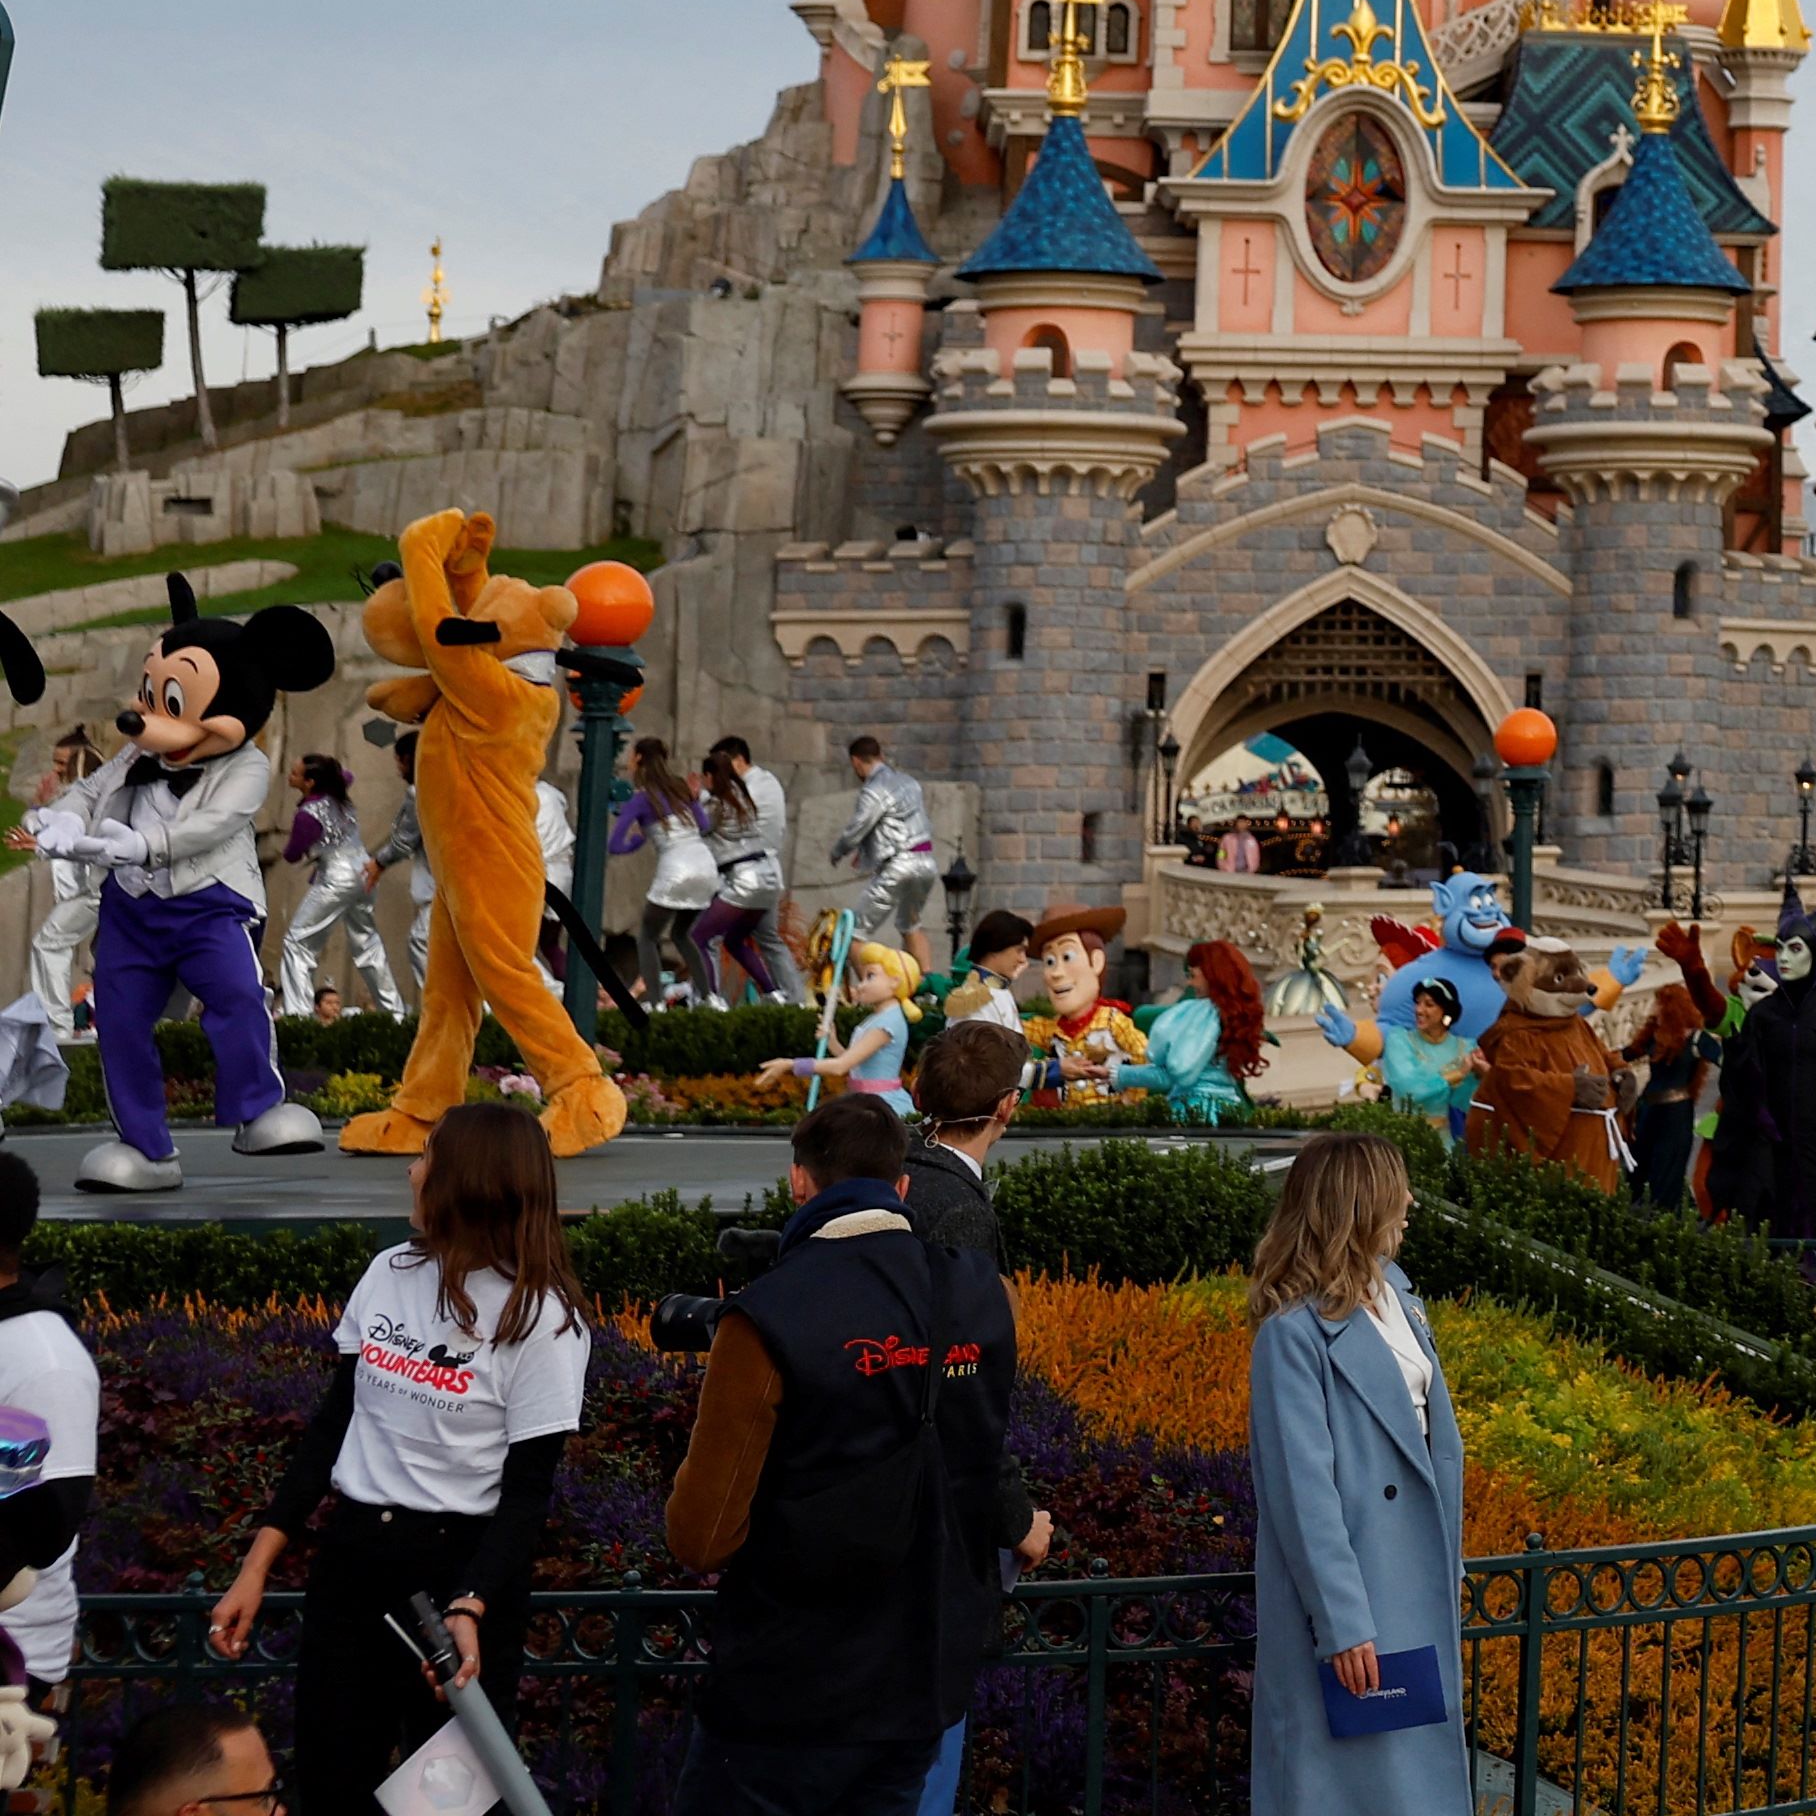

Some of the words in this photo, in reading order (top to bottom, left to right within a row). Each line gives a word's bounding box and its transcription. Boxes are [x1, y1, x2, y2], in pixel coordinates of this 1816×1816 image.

[942, 1362, 978, 1378] ARIS
[366, 1374, 396, 1394] YEARS
[410, 1391, 465, 1414] WONDER
